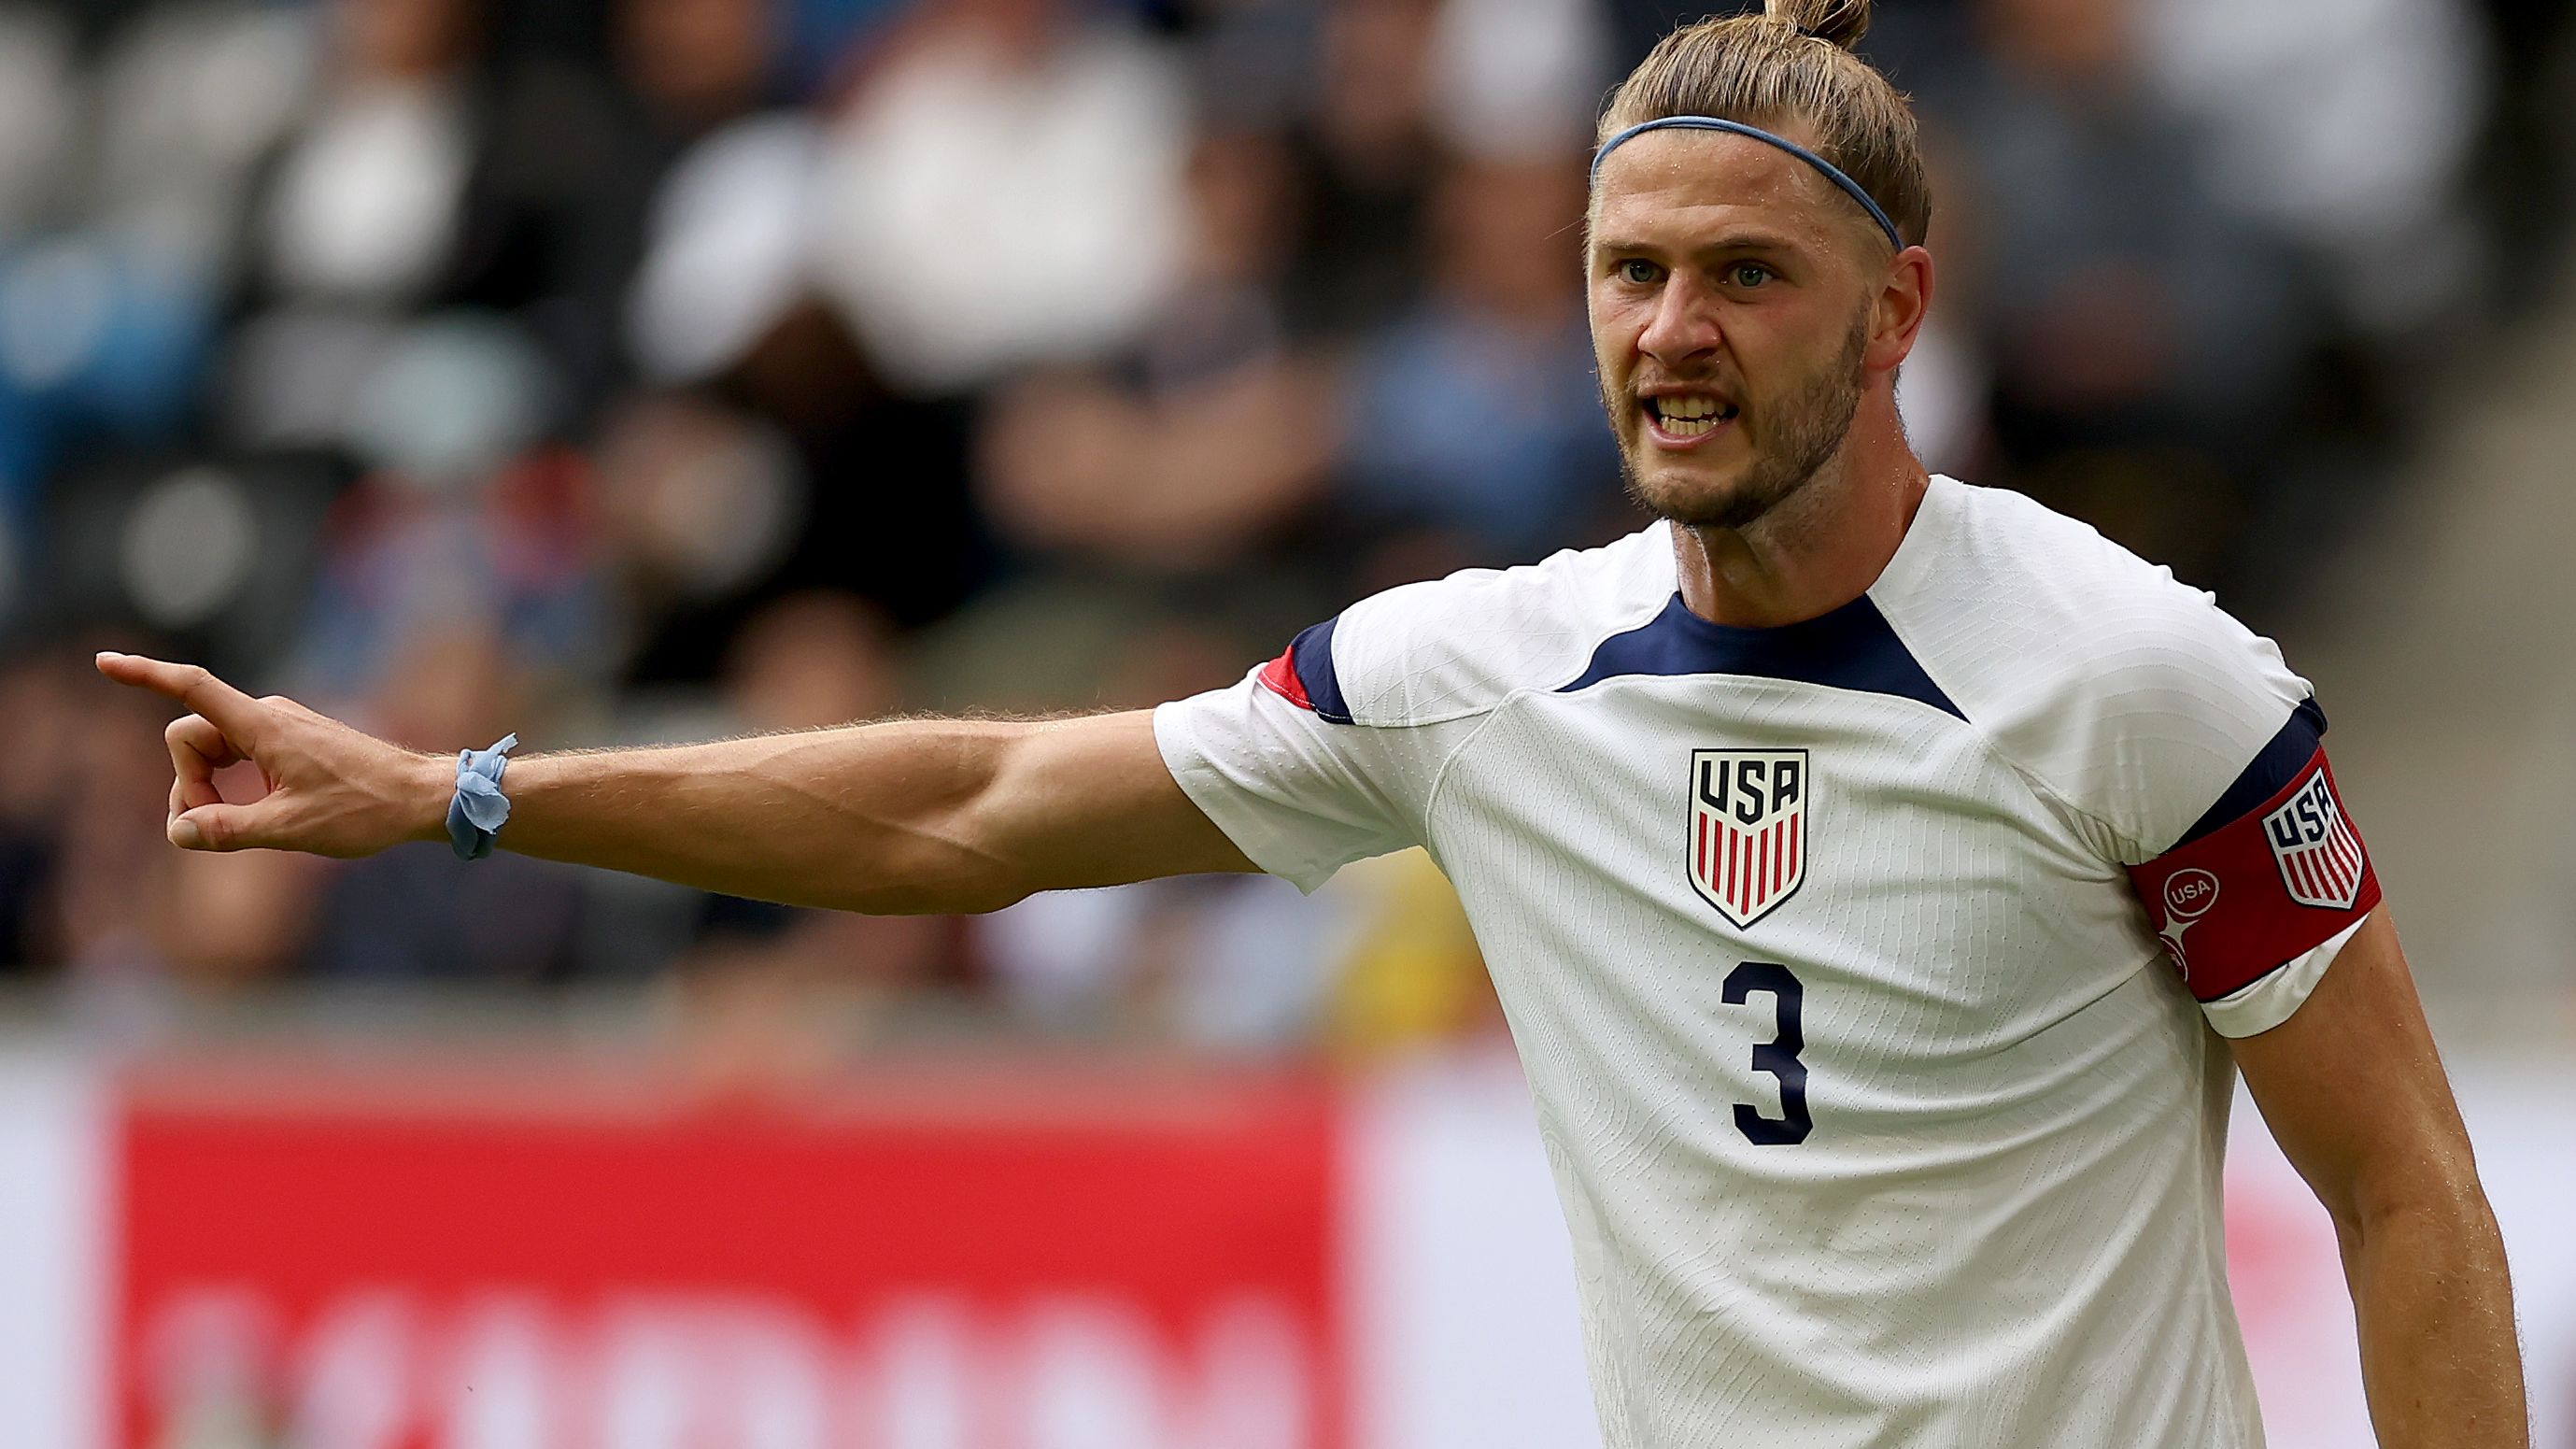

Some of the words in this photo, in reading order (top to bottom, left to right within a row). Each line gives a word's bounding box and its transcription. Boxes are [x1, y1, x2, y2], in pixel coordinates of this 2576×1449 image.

[1700, 760, 1800, 825] USA
[2271, 778, 2331, 848] USA
[2172, 879, 2211, 904] USA
[1721, 961, 1814, 1145] 3
